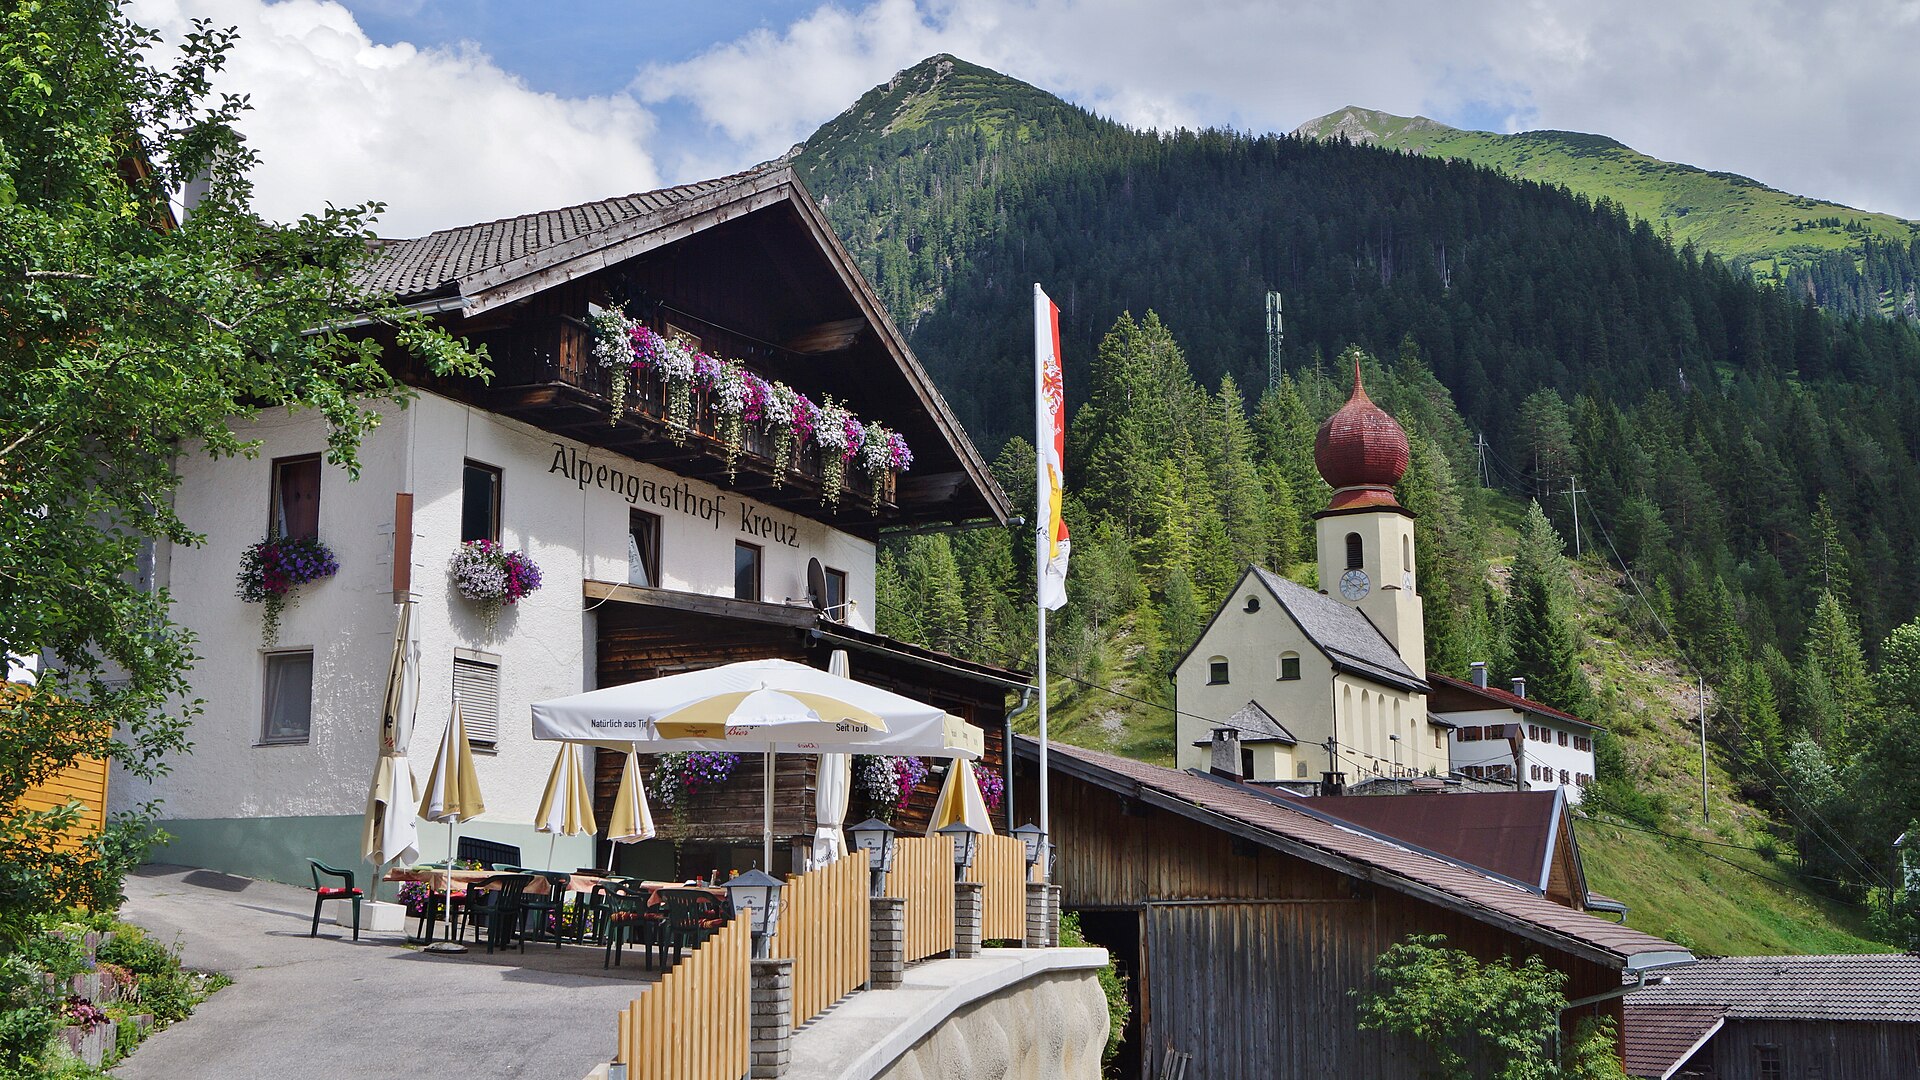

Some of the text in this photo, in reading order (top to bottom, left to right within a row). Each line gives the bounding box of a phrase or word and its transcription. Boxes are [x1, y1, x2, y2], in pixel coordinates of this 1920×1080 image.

[549, 442, 800, 549] Alpengasthof Kreuz
[591, 719, 622, 728] Natürlich
[836, 723, 849, 732] Seit
